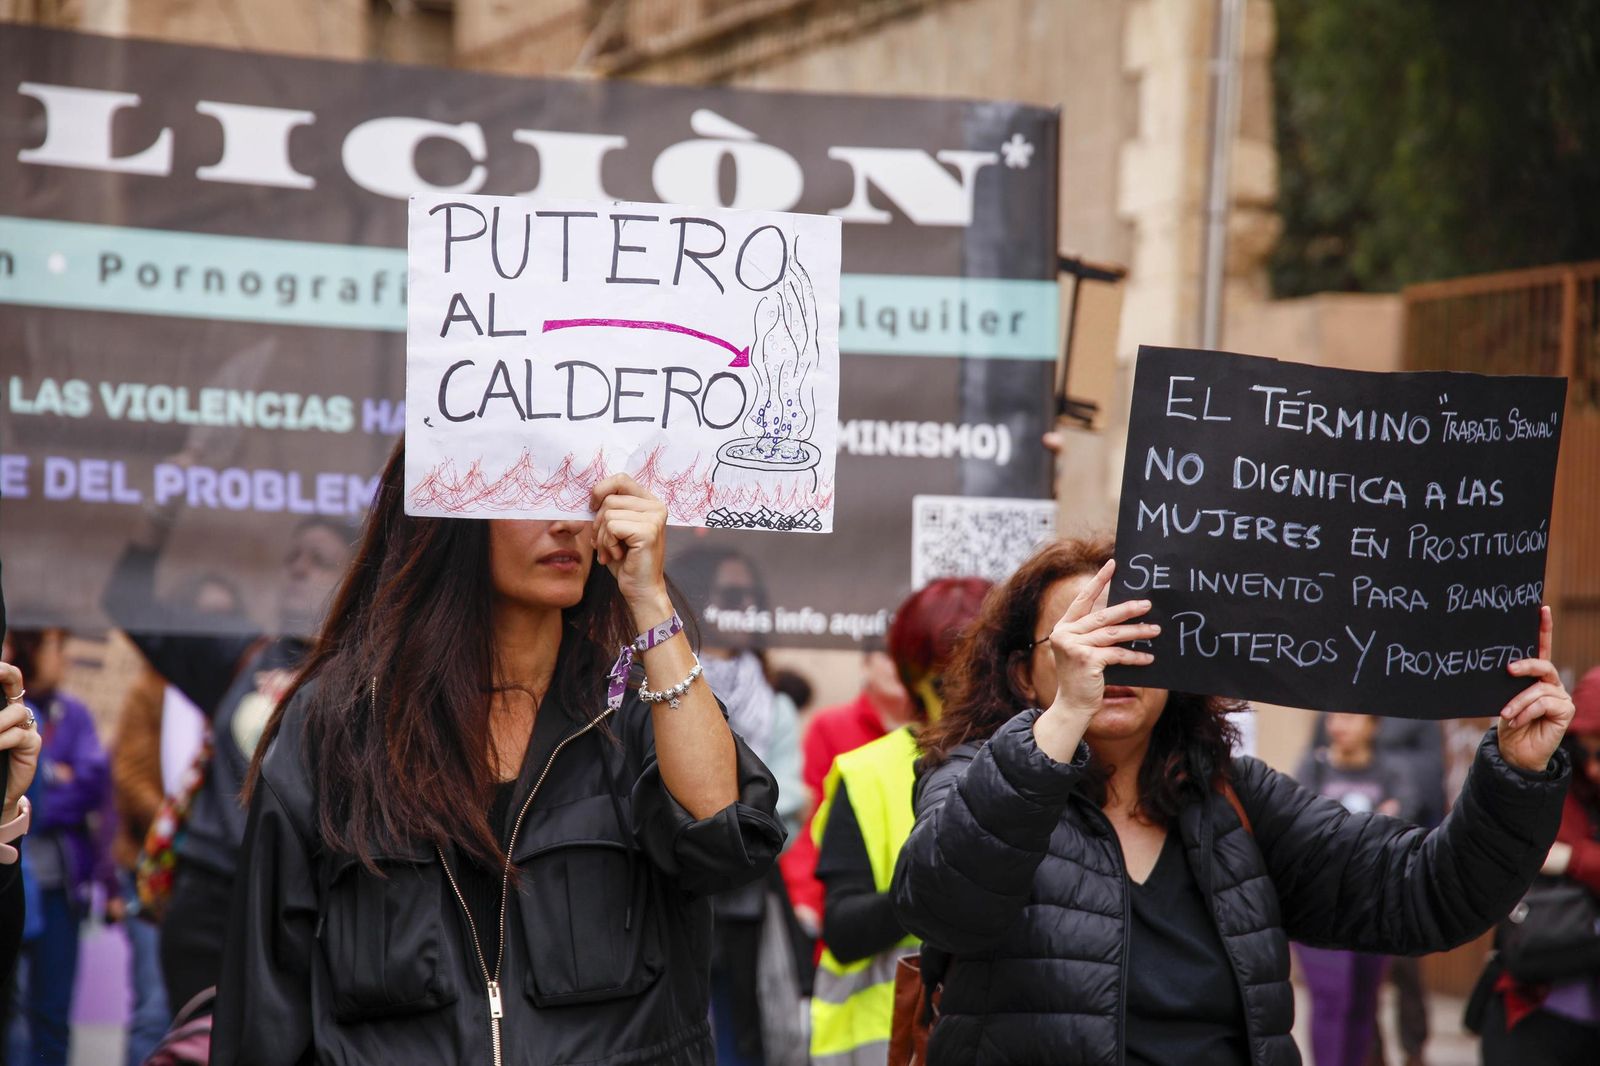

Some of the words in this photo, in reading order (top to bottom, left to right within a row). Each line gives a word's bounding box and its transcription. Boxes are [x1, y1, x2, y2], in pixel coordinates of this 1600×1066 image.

[429, 203, 788, 294] PUTERO
[440, 293, 527, 338] AL
[9, 376, 93, 418] LAS
[99, 381, 355, 433] VIOLENCIAS
[438, 359, 747, 429] CALDERO
[1166, 376, 1231, 421] EL
[1249, 384, 1430, 444] TÉRMINO
[43, 456, 141, 504] DEL
[1145, 446, 1205, 485] NO
[1233, 456, 1406, 508] DIGNIFICA
[1425, 482, 1446, 509] A
[1457, 477, 1504, 506] LAS
[1137, 499, 1321, 549] MUJERES
[1351, 527, 1389, 559] EN
[1408, 520, 1546, 562] PROSTITUCIÓN
[1123, 554, 1171, 590] SE
[1352, 576, 1429, 612] PARA
[1447, 581, 1543, 613] BLANQUEAR
[774, 605, 828, 636] info
[1172, 611, 1337, 667] PUTEROS
[1345, 625, 1376, 684] Y
